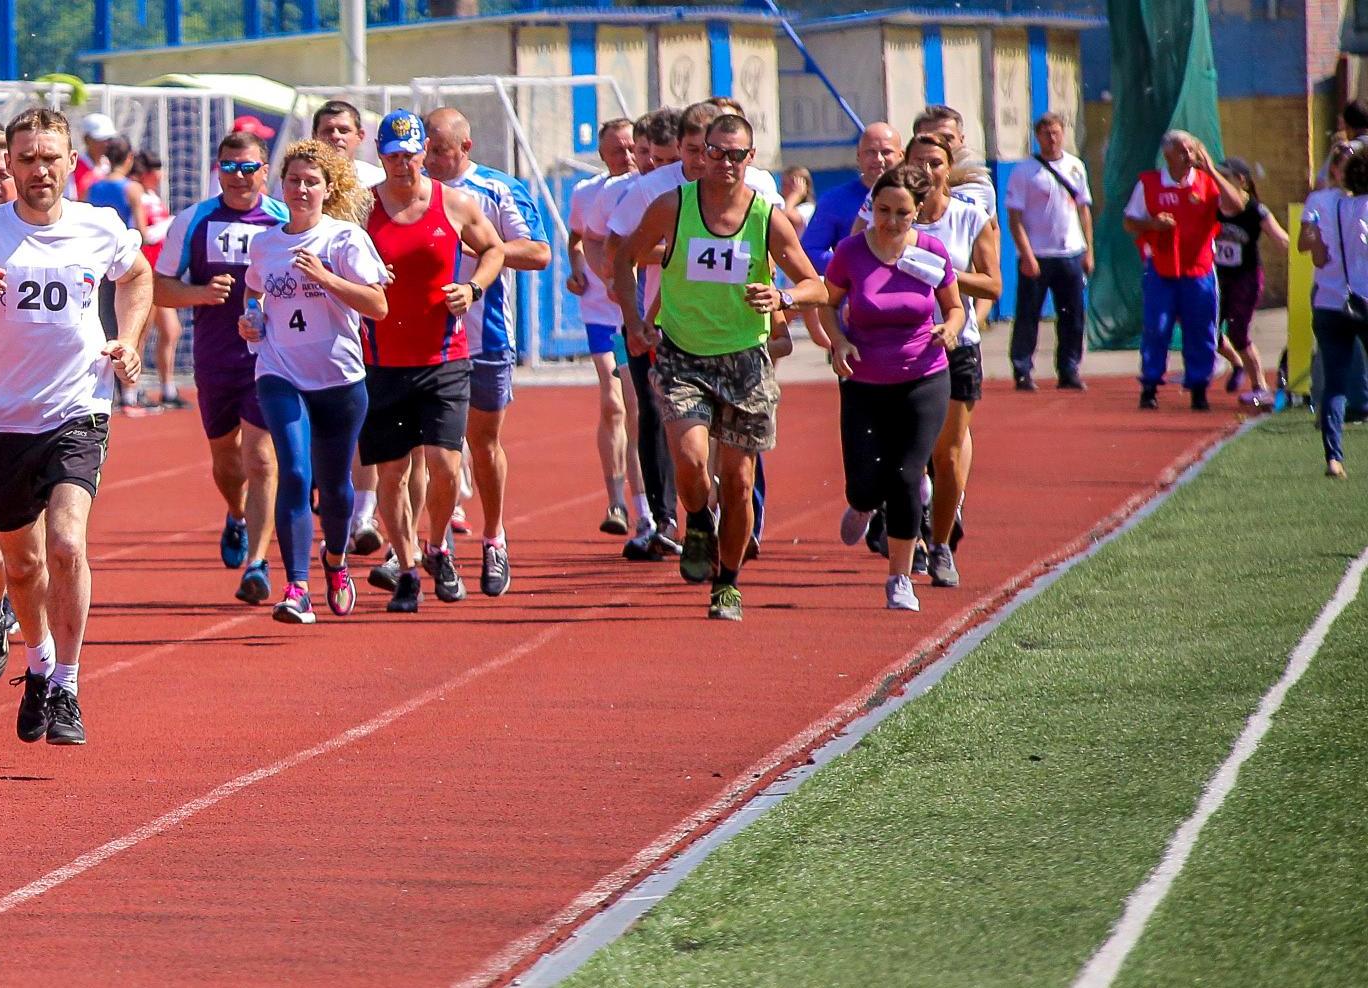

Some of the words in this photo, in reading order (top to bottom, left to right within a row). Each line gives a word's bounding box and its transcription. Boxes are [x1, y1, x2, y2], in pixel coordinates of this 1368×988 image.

[218, 233, 249, 254] 11
[697, 247, 733, 271] 41
[17, 280, 68, 312] 20
[289, 309, 307, 332] 4
